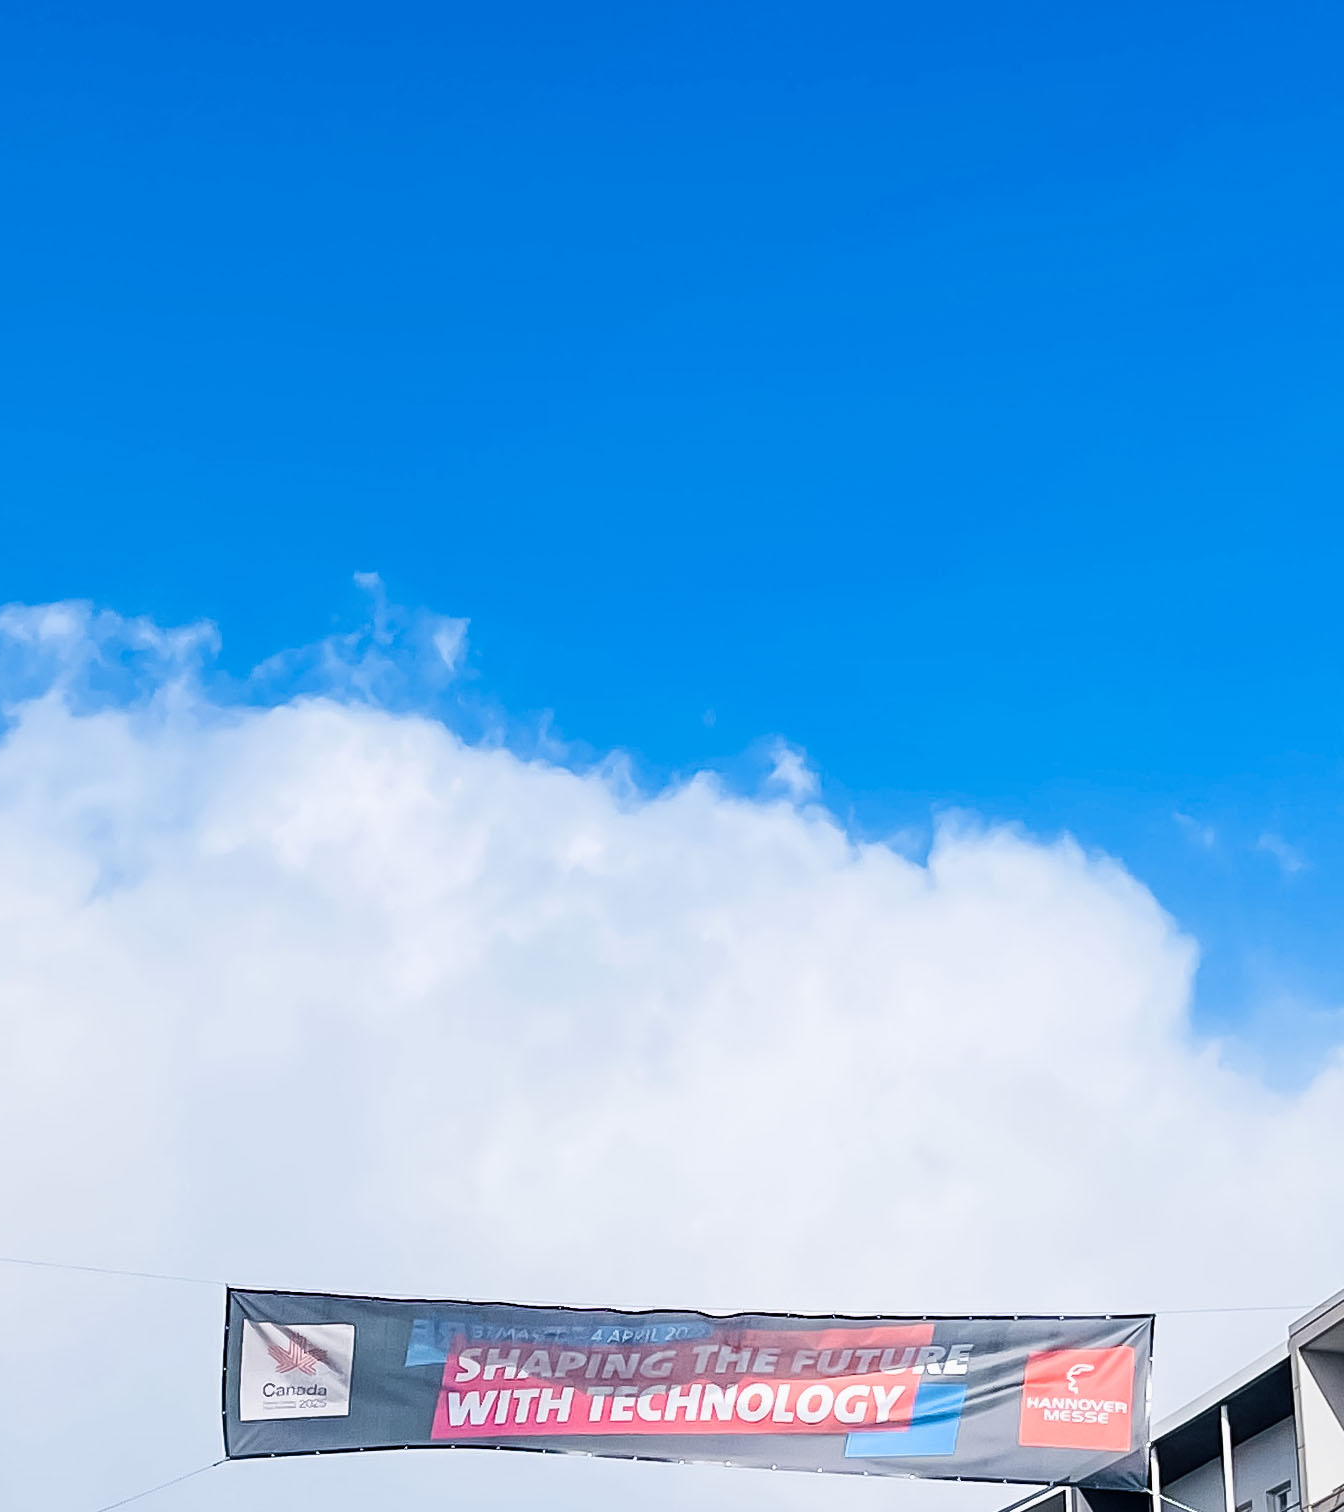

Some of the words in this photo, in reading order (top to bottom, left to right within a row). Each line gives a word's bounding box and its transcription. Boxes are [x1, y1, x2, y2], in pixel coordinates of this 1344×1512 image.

[455, 1348, 677, 1383] SHAPING
[692, 1344, 779, 1375] THE
[791, 1343, 974, 1376] FUTURE
[262, 1383, 327, 1398] Canada
[448, 1386, 575, 1427] WITH
[586, 1383, 906, 1424] TECHNOLOGY
[1026, 1396, 1128, 1414] HANNOVER
[1043, 1409, 1110, 1425] MESSE
